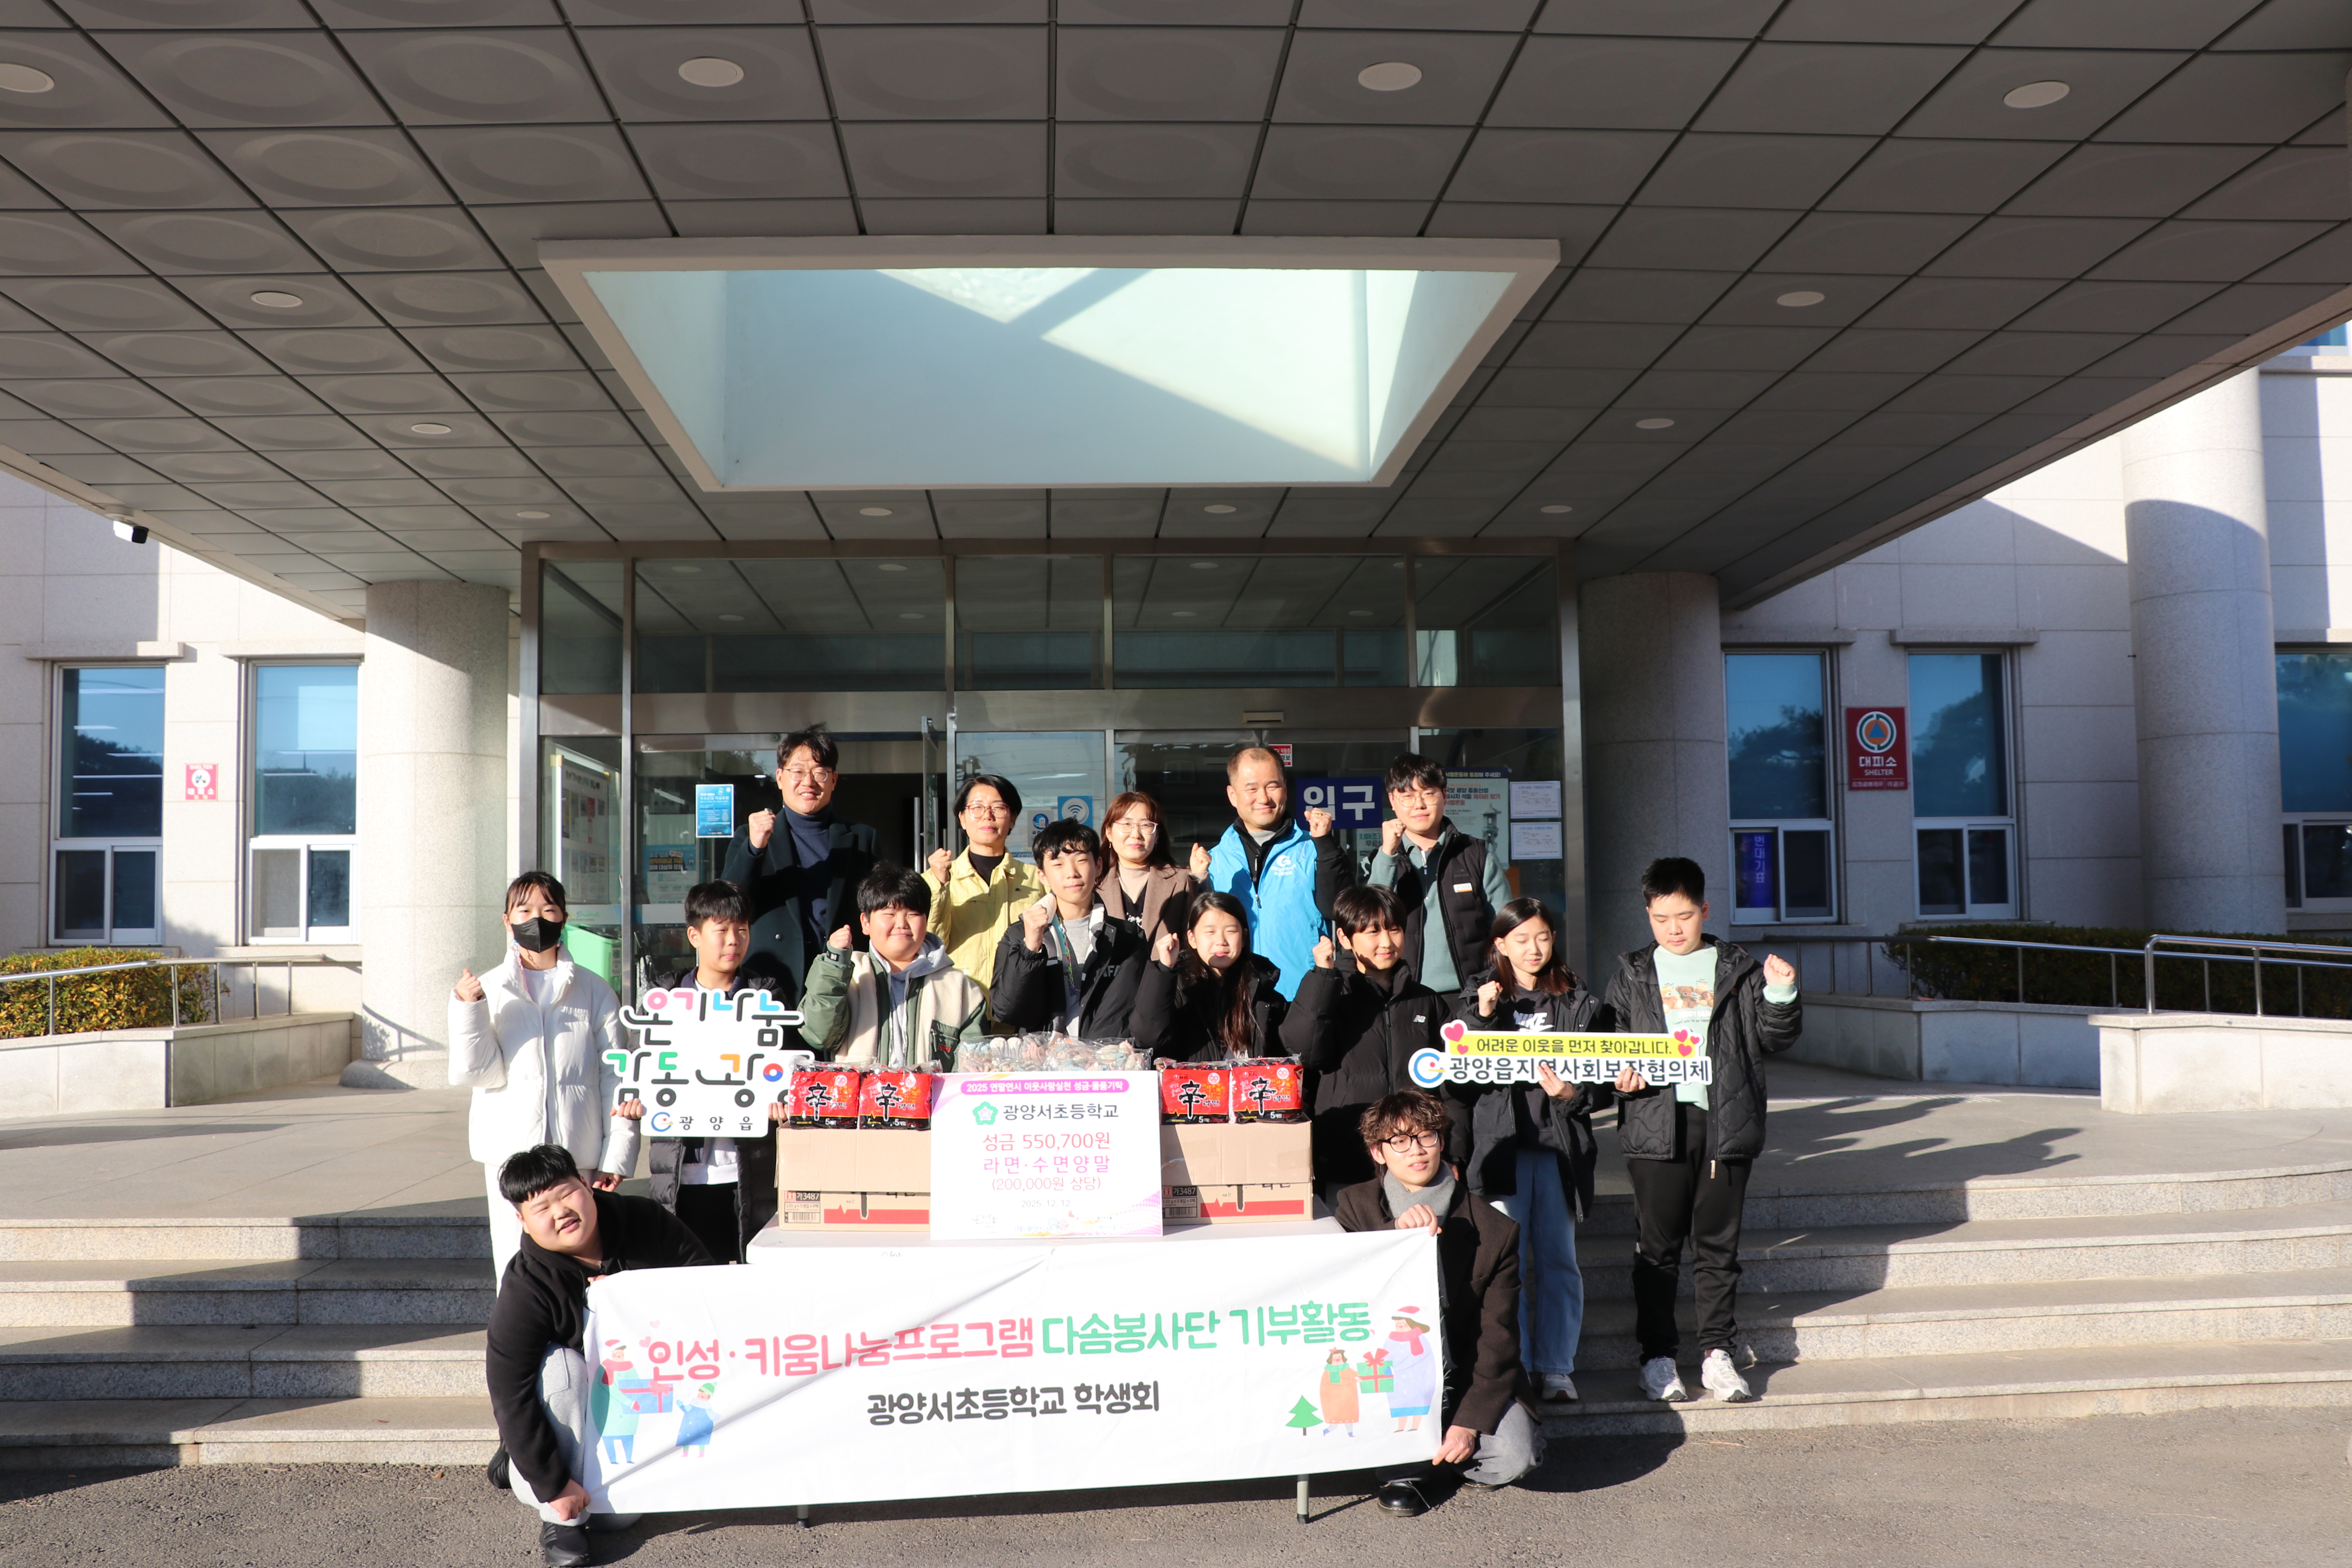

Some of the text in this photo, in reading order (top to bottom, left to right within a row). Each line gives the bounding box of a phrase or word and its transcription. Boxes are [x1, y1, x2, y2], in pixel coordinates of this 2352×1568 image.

[1859, 756, 1897, 767] 대피소
[1303, 785, 1375, 821] 입구
[624, 991, 800, 1047] 온기나눔
[1513, 1010, 1548, 1030] NIKE
[1677, 1010, 1697, 1019] TEDDY
[1477, 1039, 1672, 1055] 어려운 이웃을 먼저 찾아갑니다.
[967, 1084, 988, 1092] 2025
[989, 1082, 1022, 1092] 연말연시
[1024, 1081, 1071, 1091] 이웃사랑실천
[1249, 1076, 1278, 1116] 辛
[805, 1082, 833, 1121] 辛
[875, 1083, 903, 1122] 辛
[1178, 1080, 1207, 1119] 辛
[1003, 1103, 1120, 1121] 광양서초등학교
[982, 1132, 1111, 1151] 성금 550,700원
[992, 1176, 1101, 1192] (200,000원 상당)
[1173, 1187, 1196, 1196] 가3487
[797, 1192, 819, 1201] 가3487
[1061, 1199, 1072, 1207] 12.
[1042, 1310, 1221, 1356] 다솜봉사단
[1229, 1300, 1371, 1347] 기부활동
[867, 1381, 1161, 1426] 광양서초등학교 학생회
